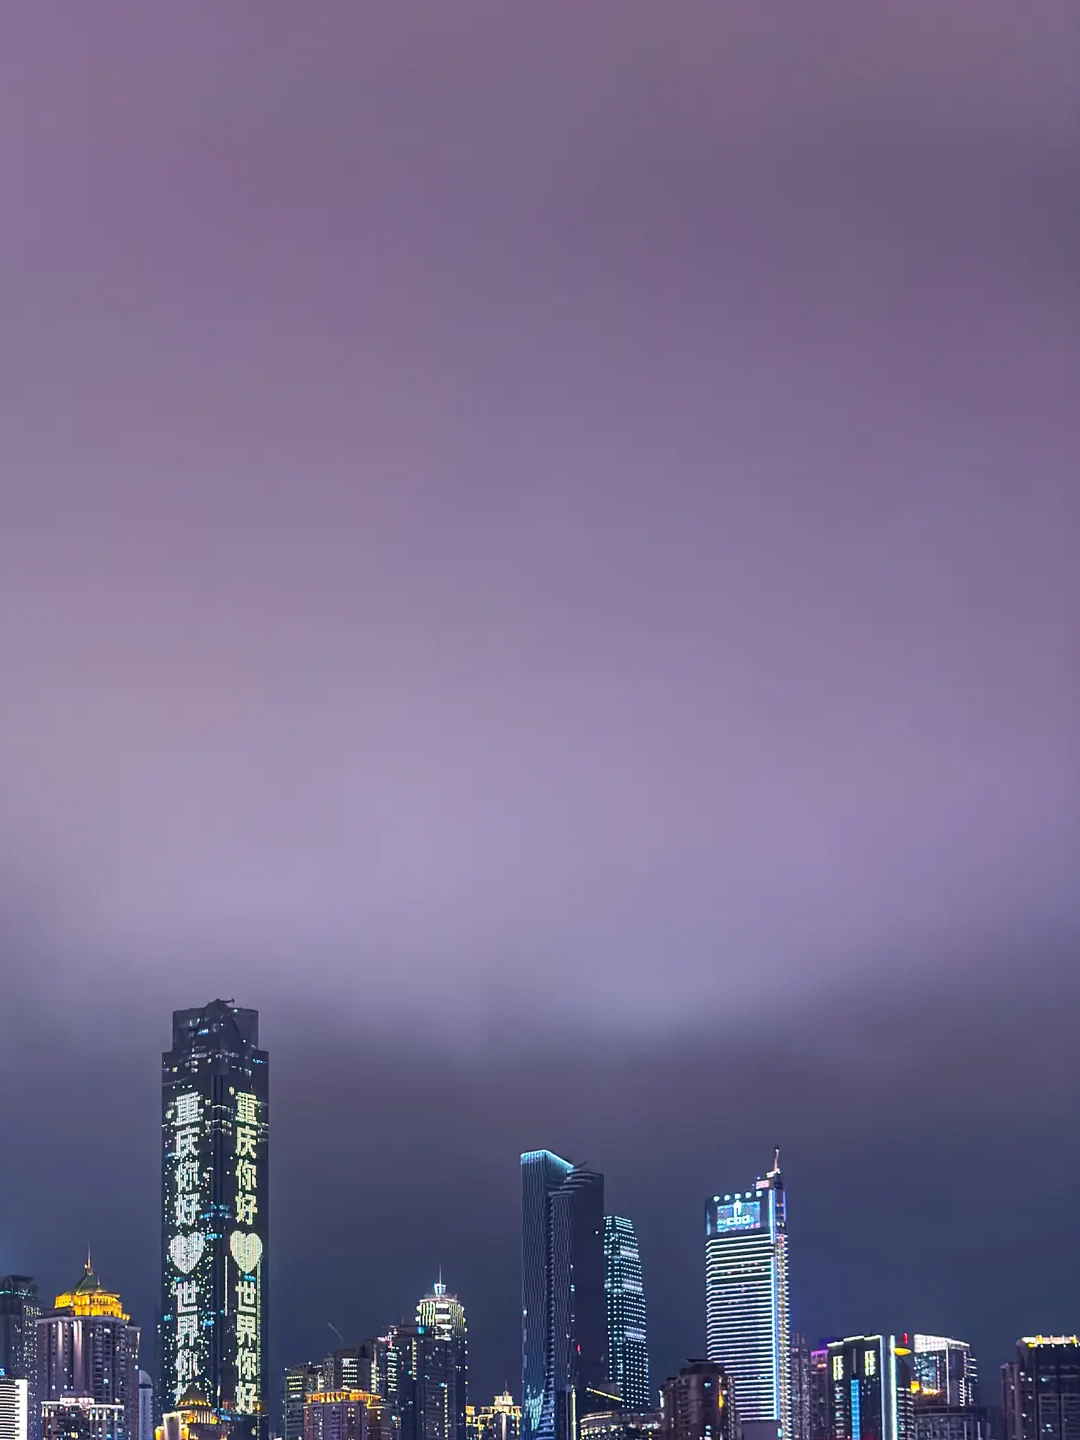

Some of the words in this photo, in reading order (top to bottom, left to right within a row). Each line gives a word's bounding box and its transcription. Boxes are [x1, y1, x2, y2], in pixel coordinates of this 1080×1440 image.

[174, 1092, 202, 1226] 重庆你好
[235, 1092, 258, 1226] 重庆你好
[235, 1280, 258, 1415] 世界你好
